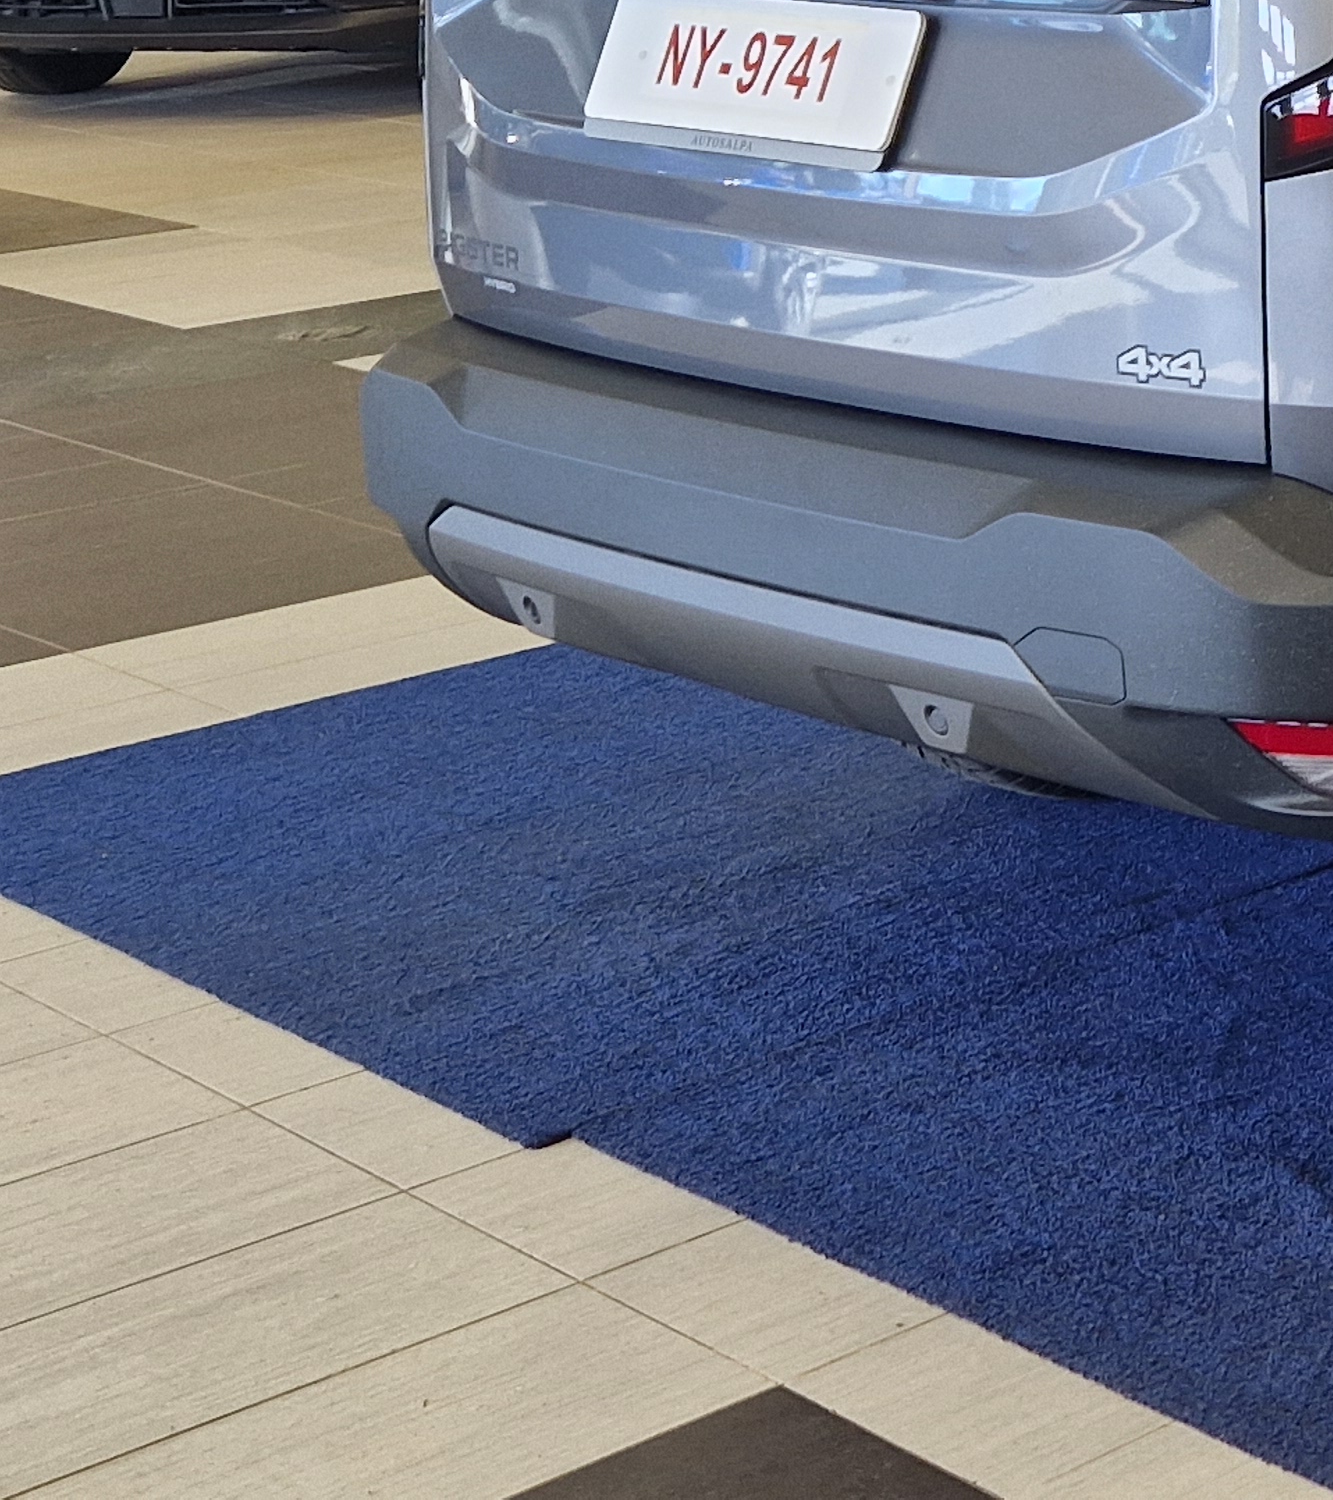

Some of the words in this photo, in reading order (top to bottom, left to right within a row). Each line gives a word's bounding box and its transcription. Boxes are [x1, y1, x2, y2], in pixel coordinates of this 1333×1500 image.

[655, 23, 842, 103] NY-9741
[690, 135, 752, 152] AUTOSALPA
[1116, 344, 1206, 389] 4x4
